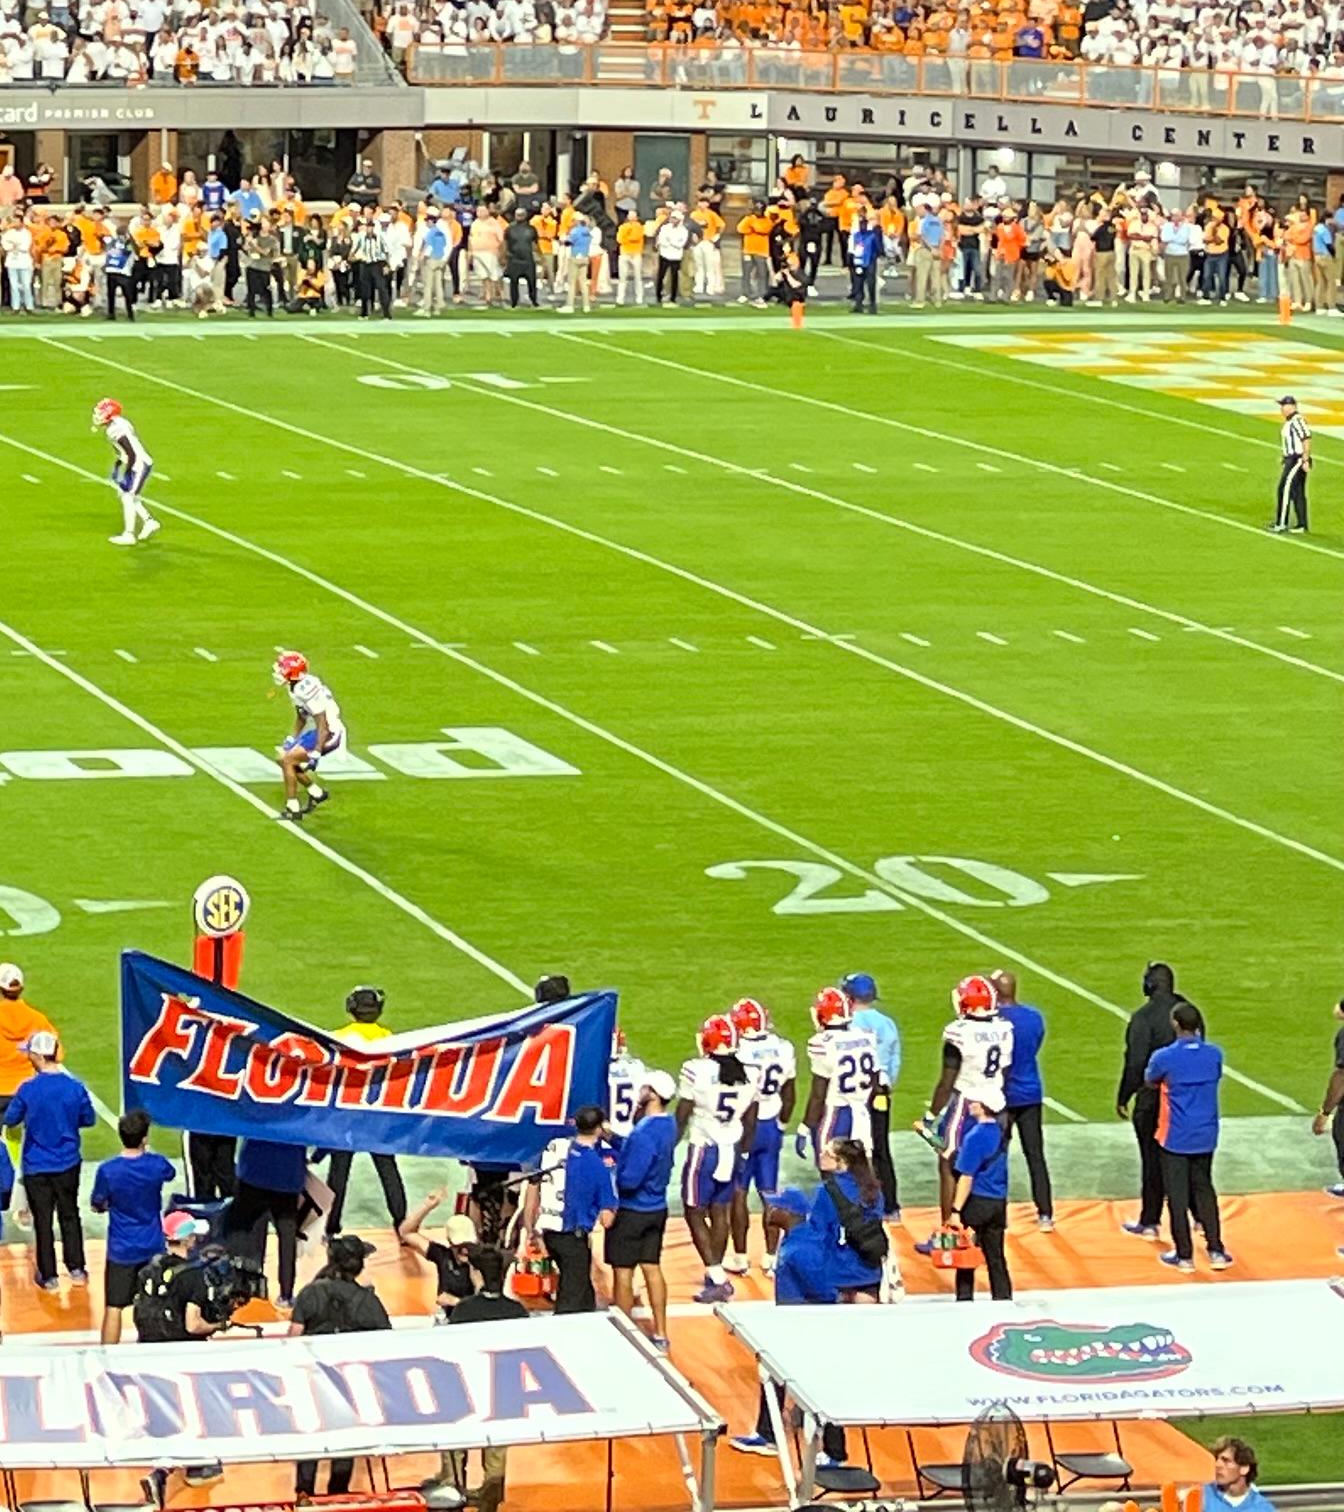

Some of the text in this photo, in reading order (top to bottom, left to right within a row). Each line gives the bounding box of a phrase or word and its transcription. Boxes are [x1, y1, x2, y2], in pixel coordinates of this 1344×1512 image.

[115, 108, 155, 119] CLUB
[693, 99, 716, 120] T
[749, 103, 1316, 155] LAURICELLA CENTER
[704, 855, 1050, 915] 20
[202, 887, 243, 931] SEC
[127, 992, 578, 1126] FLORIDA
[837, 1052, 874, 1093] 29
[983, 1044, 1001, 1078] 8
[713, 1091, 739, 1123] 5
[965, 1384, 1286, 1407] WWW.FLORIDAGATORS.COM
